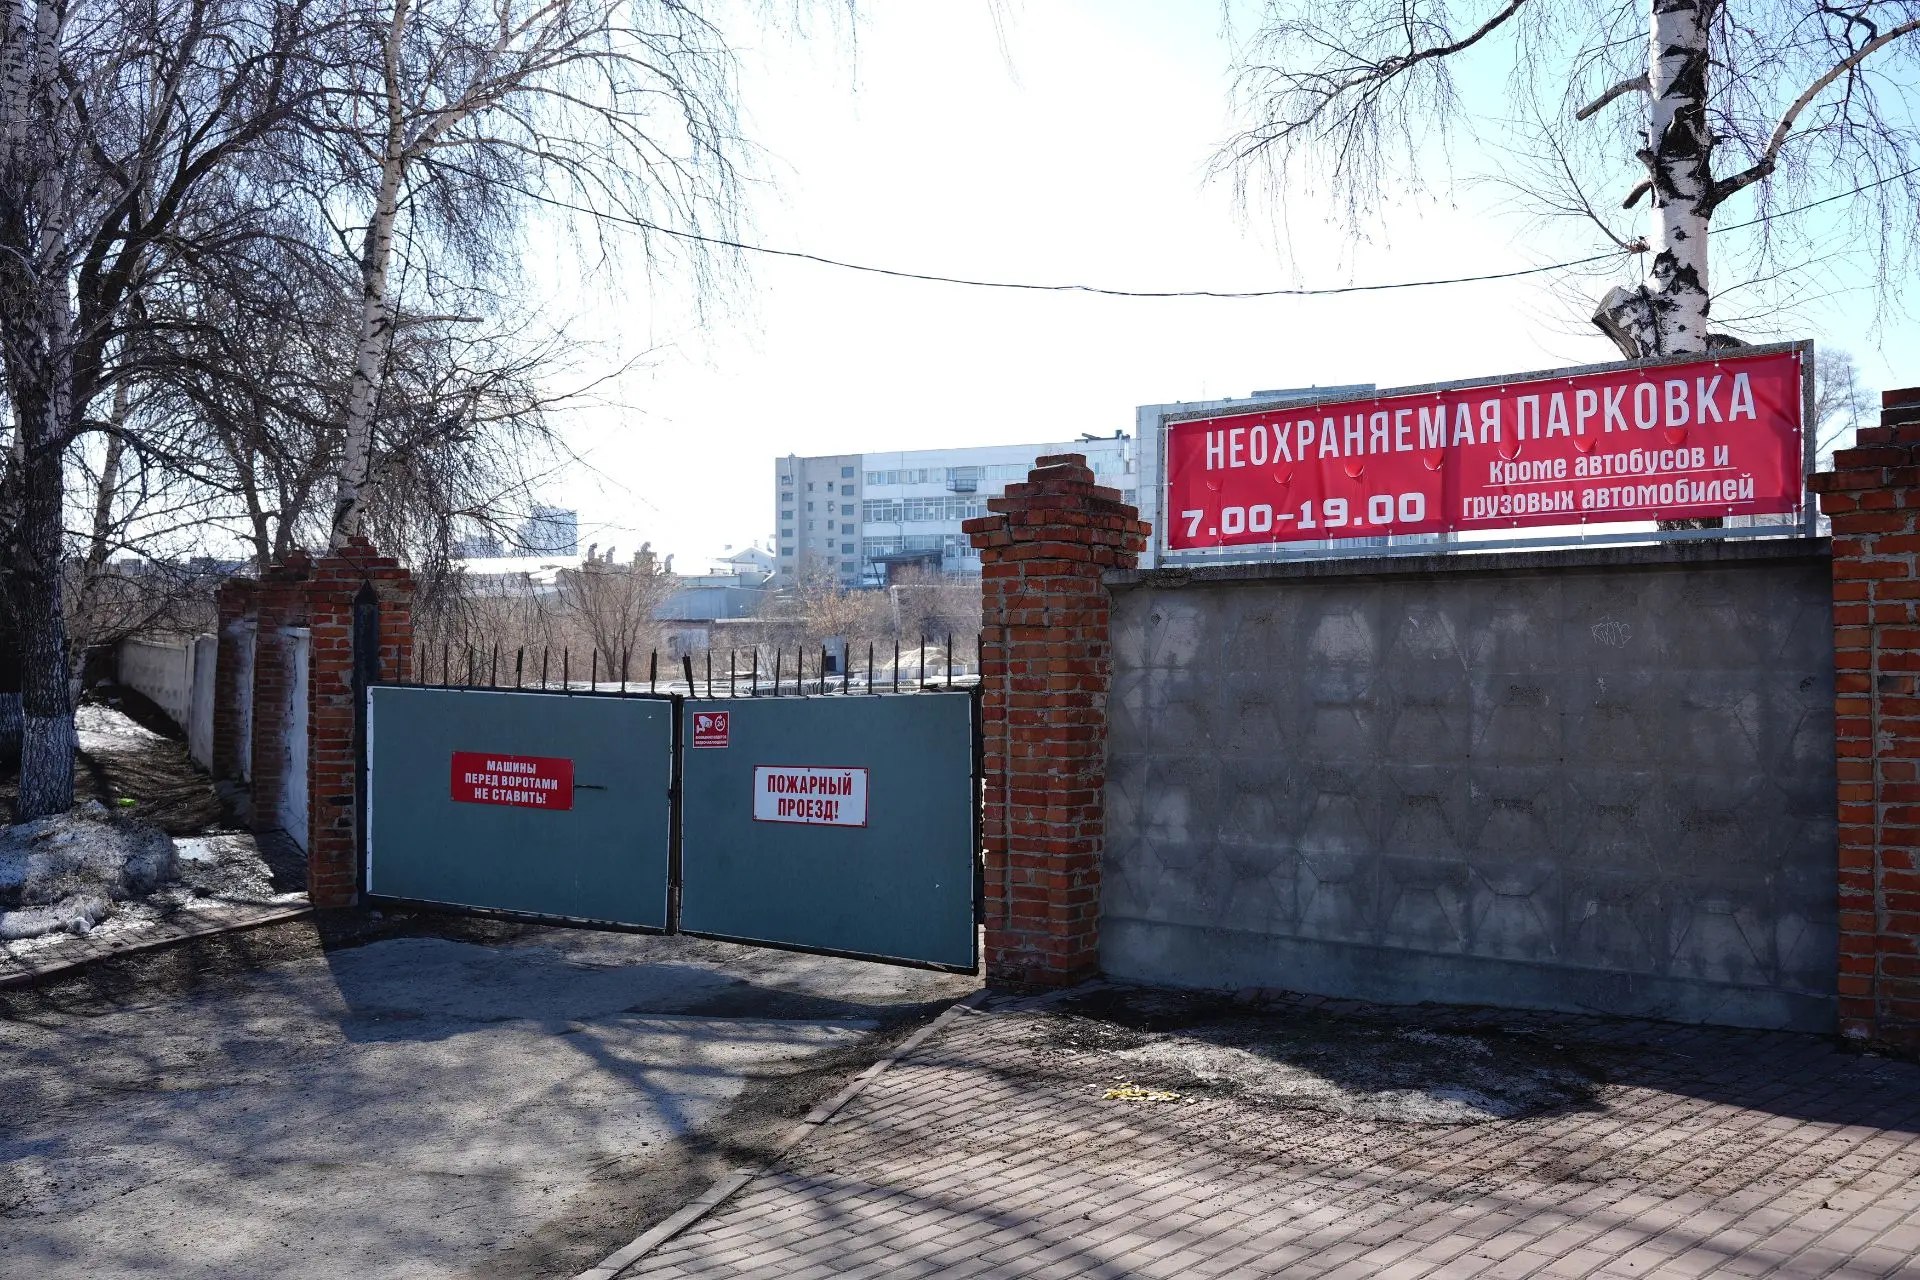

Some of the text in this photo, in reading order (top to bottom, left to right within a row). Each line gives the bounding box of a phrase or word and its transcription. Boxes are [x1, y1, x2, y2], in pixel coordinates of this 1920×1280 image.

[1206, 372, 1757, 471] НЕОХРАНЯЕМАЯ ПАРКОВКА
[1574, 447, 1706, 477] автобусов
[1713, 444, 1729, 467] и
[1463, 472, 1754, 518] грузовых автомобилей
[486, 760, 537, 775] МАШИНЫ
[465, 772, 558, 790] ПЕРЕД ВОРОТАМИ
[767, 772, 853, 797] ПОЖАРНЫЙ
[474, 787, 547, 804] НЕ СТАВИТЬ!
[777, 798, 840, 821] ПРОЕЗД!
